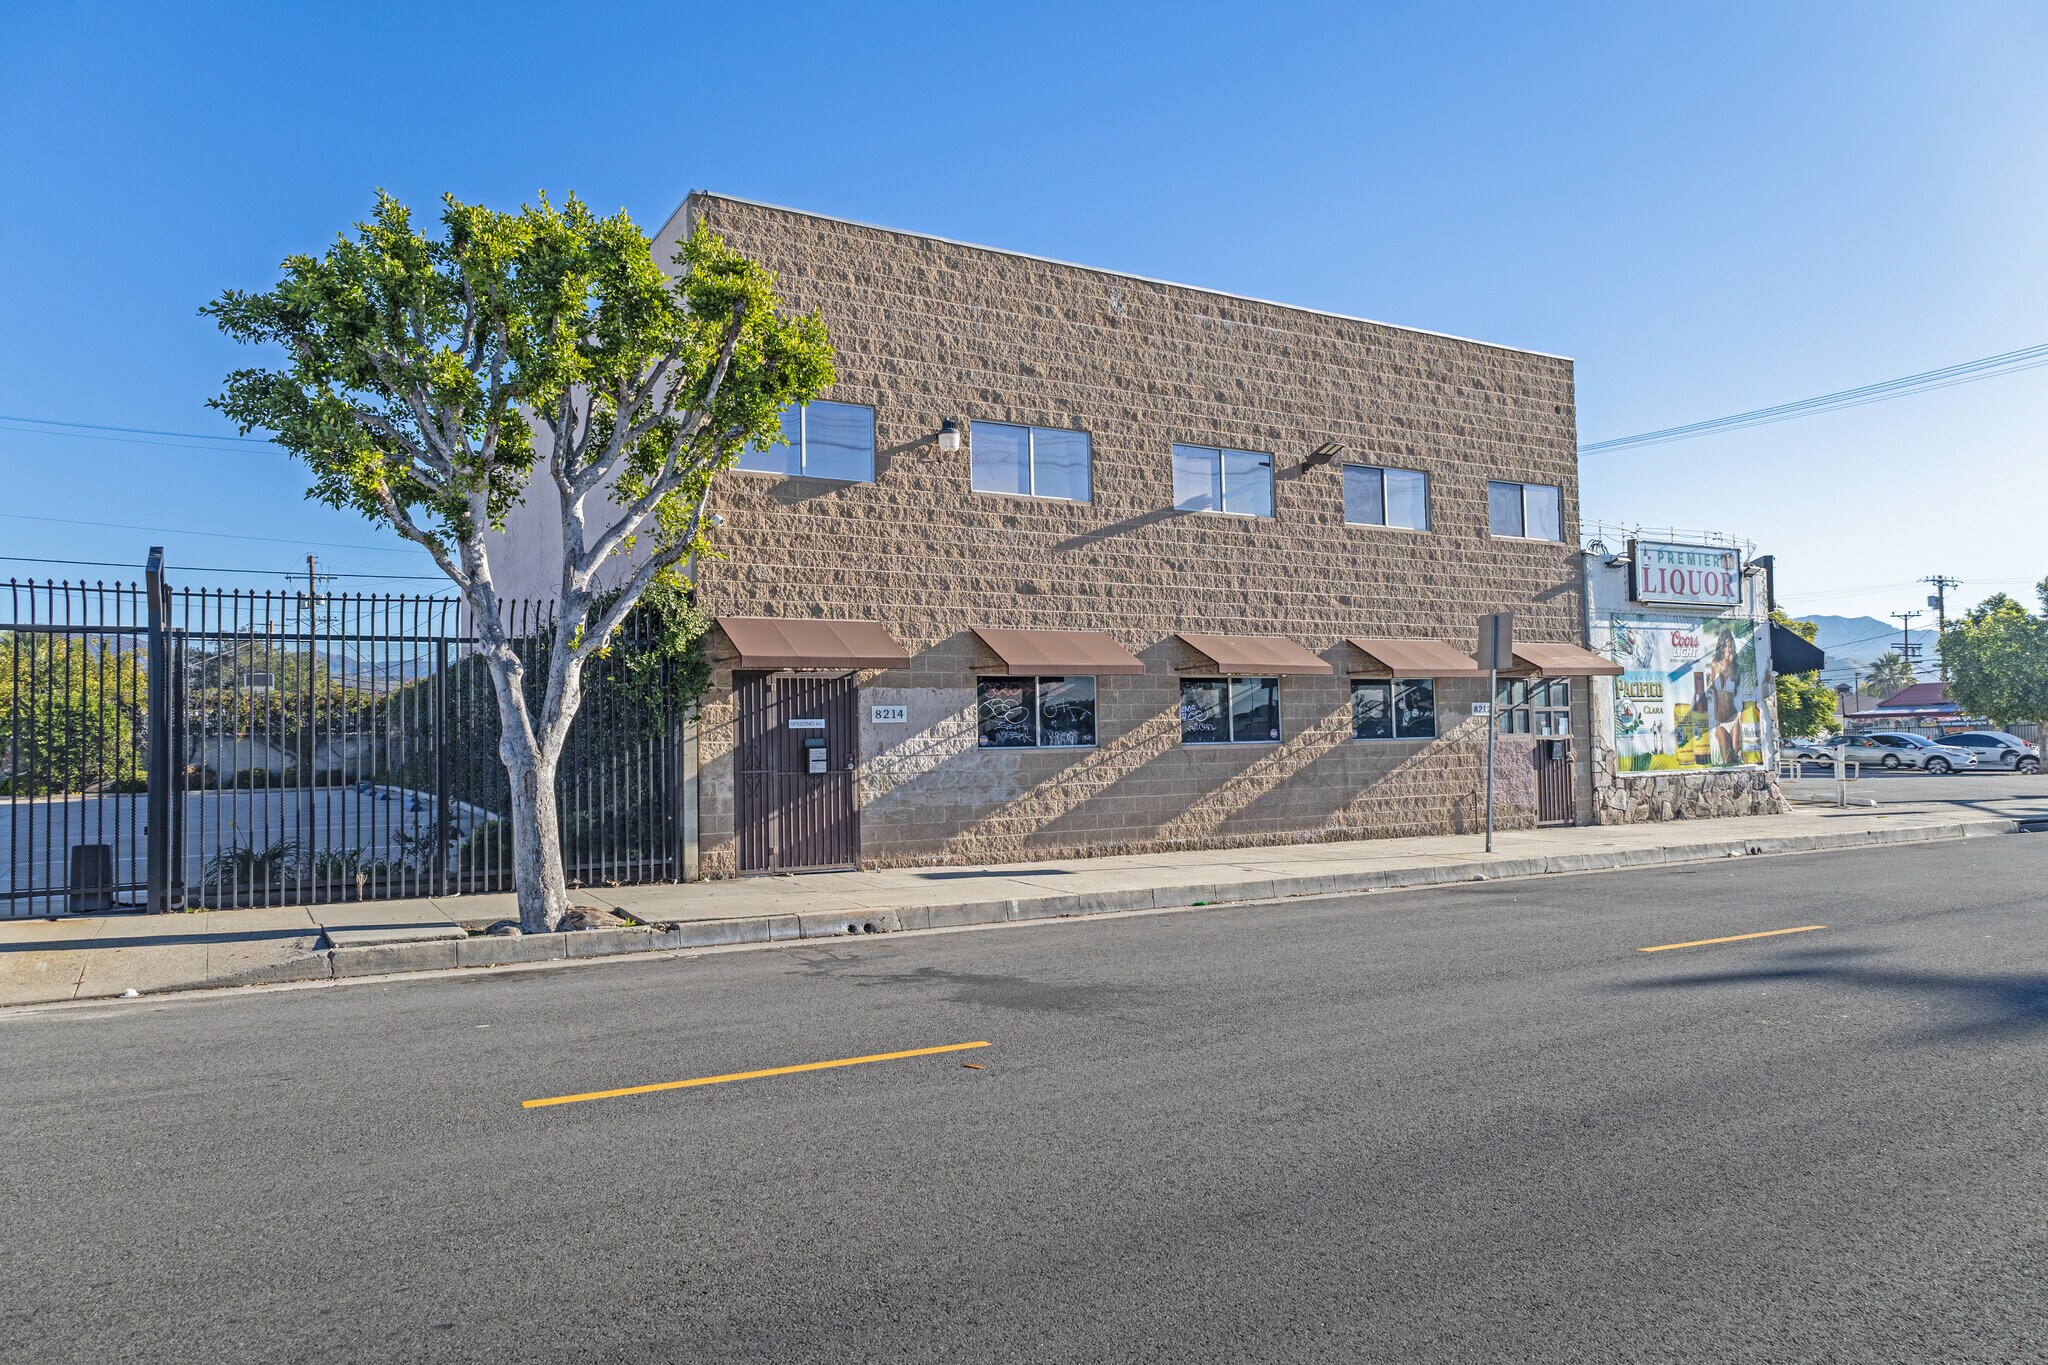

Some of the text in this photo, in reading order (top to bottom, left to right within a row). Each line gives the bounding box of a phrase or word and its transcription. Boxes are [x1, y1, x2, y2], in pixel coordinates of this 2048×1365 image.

[1657, 550, 1720, 568] PREMIER
[1642, 567, 1735, 598] LIQUOR
[1670, 630, 1699, 648] Coors
[1673, 647, 1698, 658] LIGHT
[1615, 677, 1663, 699] PACIFICO
[875, 709, 904, 719] 8214
[1643, 705, 1664, 715] CLARA
